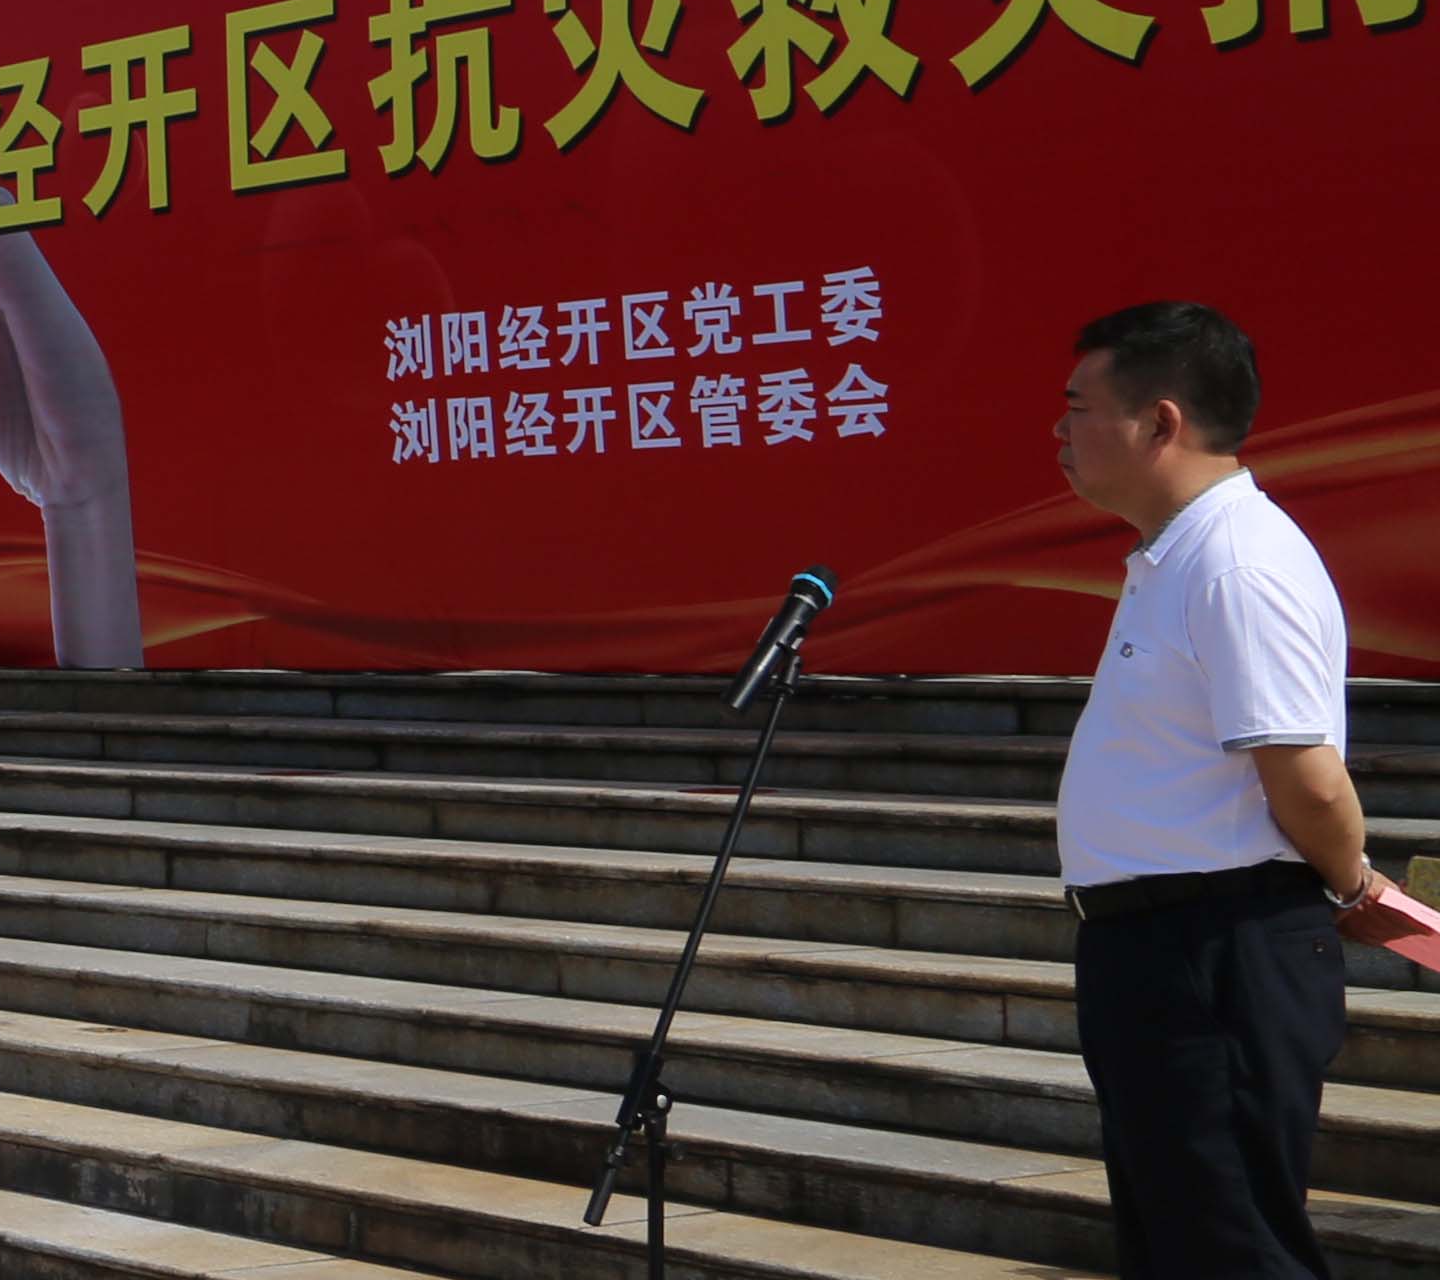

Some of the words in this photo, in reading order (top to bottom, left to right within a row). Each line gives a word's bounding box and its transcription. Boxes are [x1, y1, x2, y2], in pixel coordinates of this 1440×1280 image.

[384, 265, 882, 381] 浏阳经开区党工委
[389, 362, 888, 464] 浏阳经开区管委会
